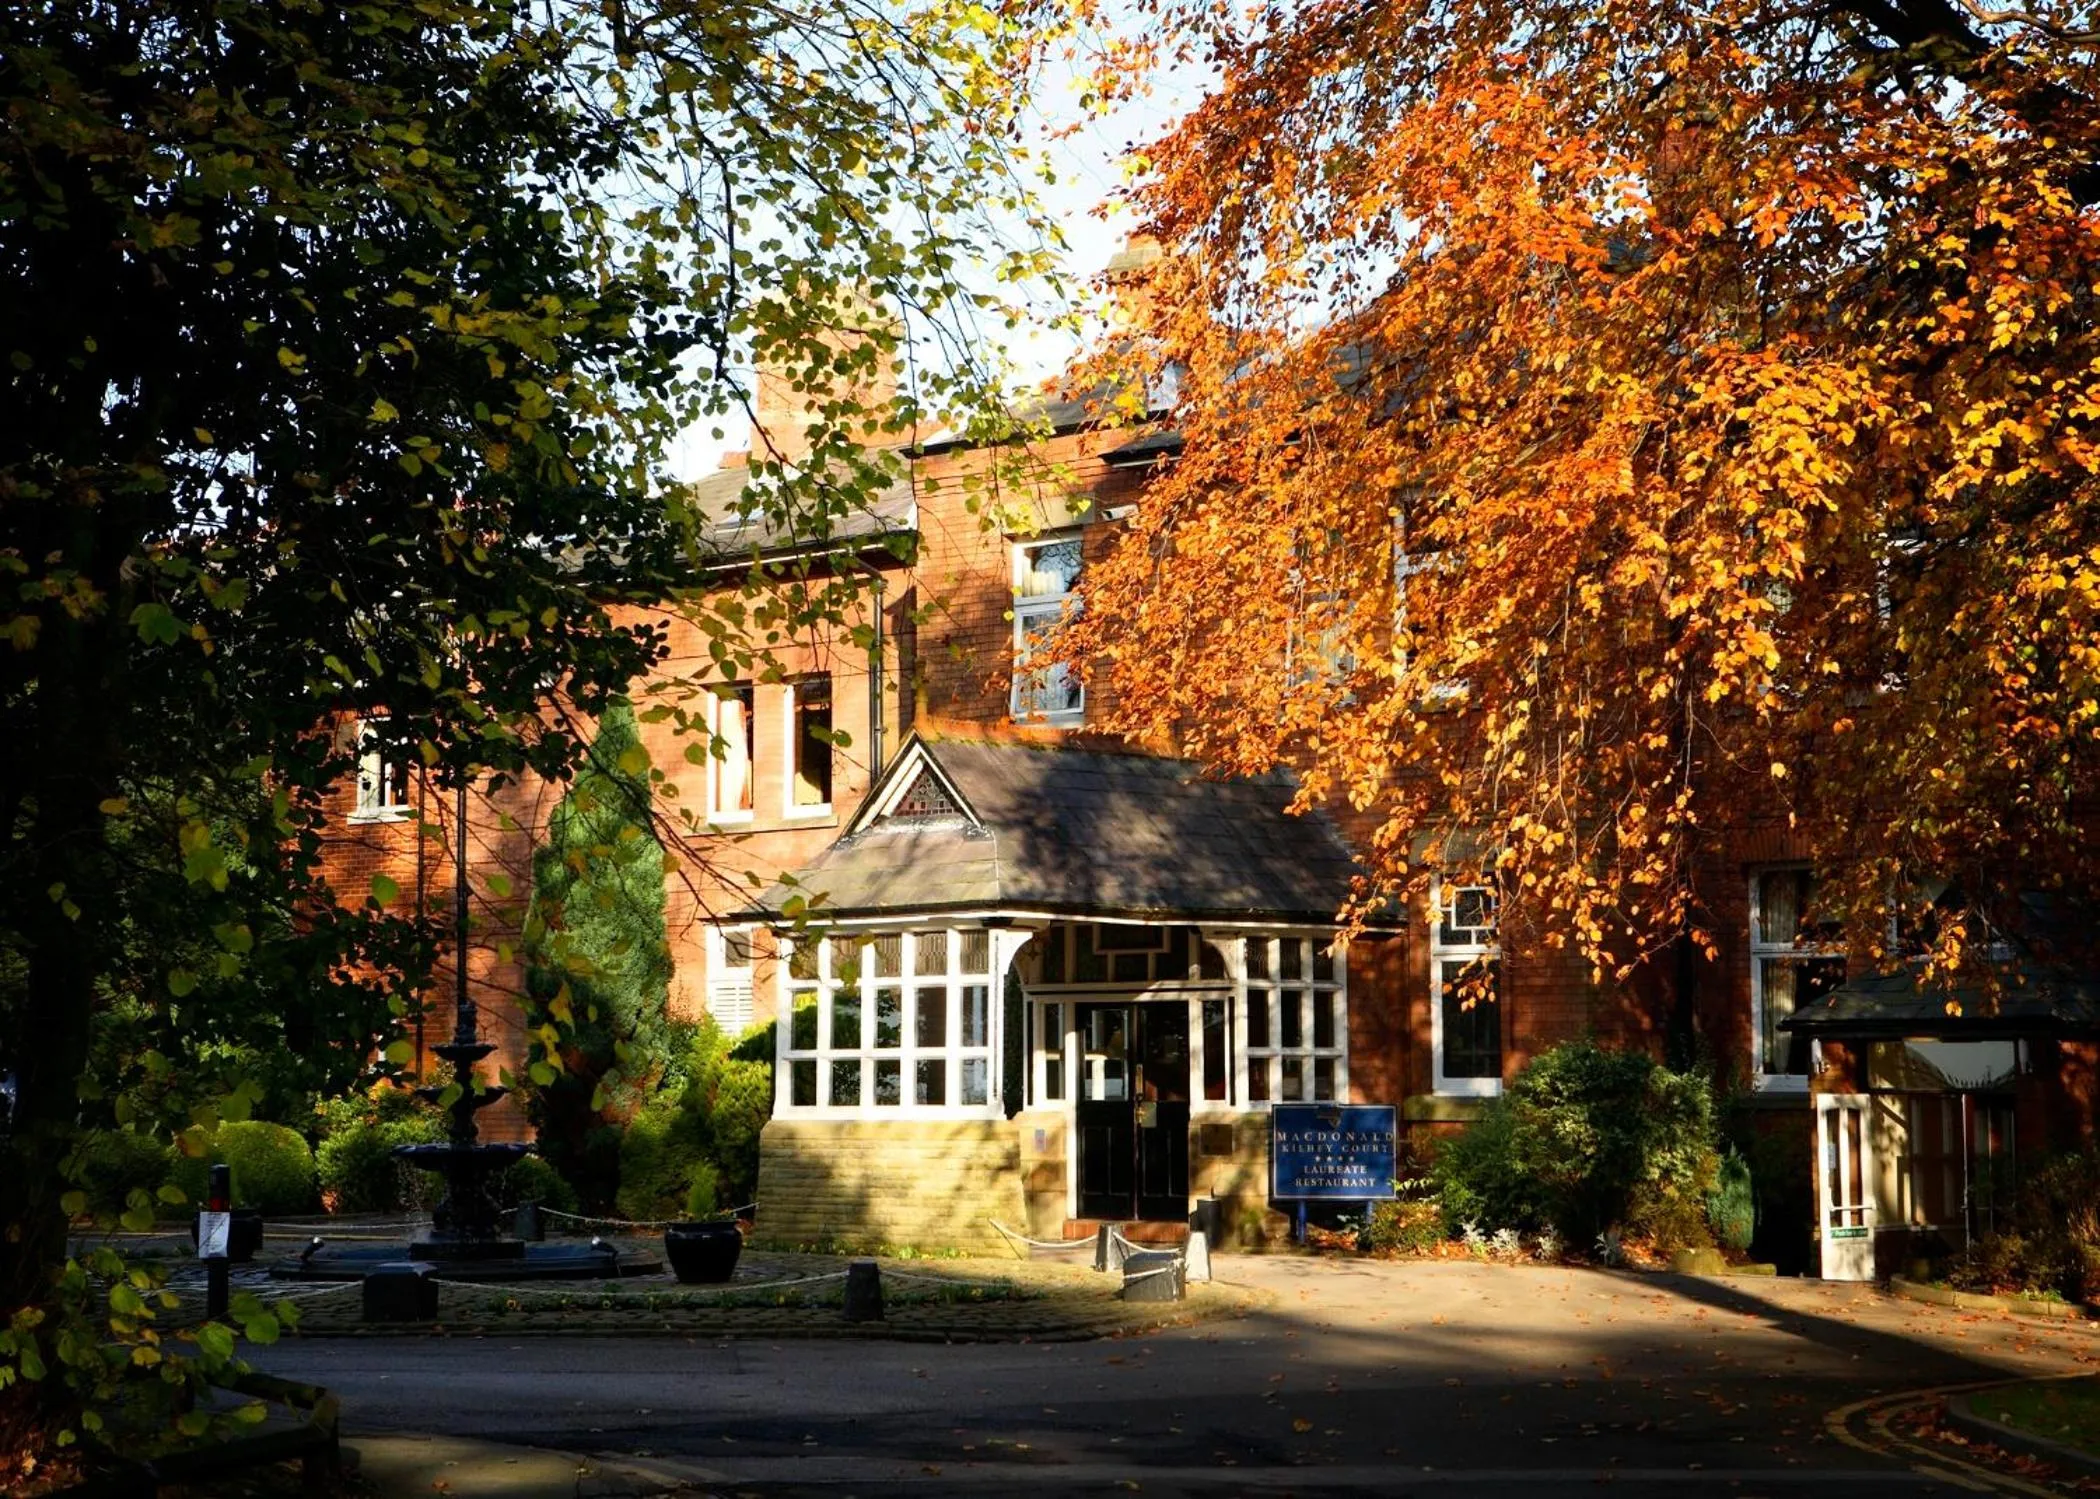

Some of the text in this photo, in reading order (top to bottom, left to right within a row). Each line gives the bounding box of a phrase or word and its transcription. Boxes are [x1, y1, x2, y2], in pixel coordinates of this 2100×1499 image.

[1276, 1131, 1394, 1141] MACDONALD
[1342, 1144, 1389, 1153] COURT
[1304, 1165, 1368, 1174] LAUREATE
[1295, 1178, 1376, 1187] RESTAURANT
